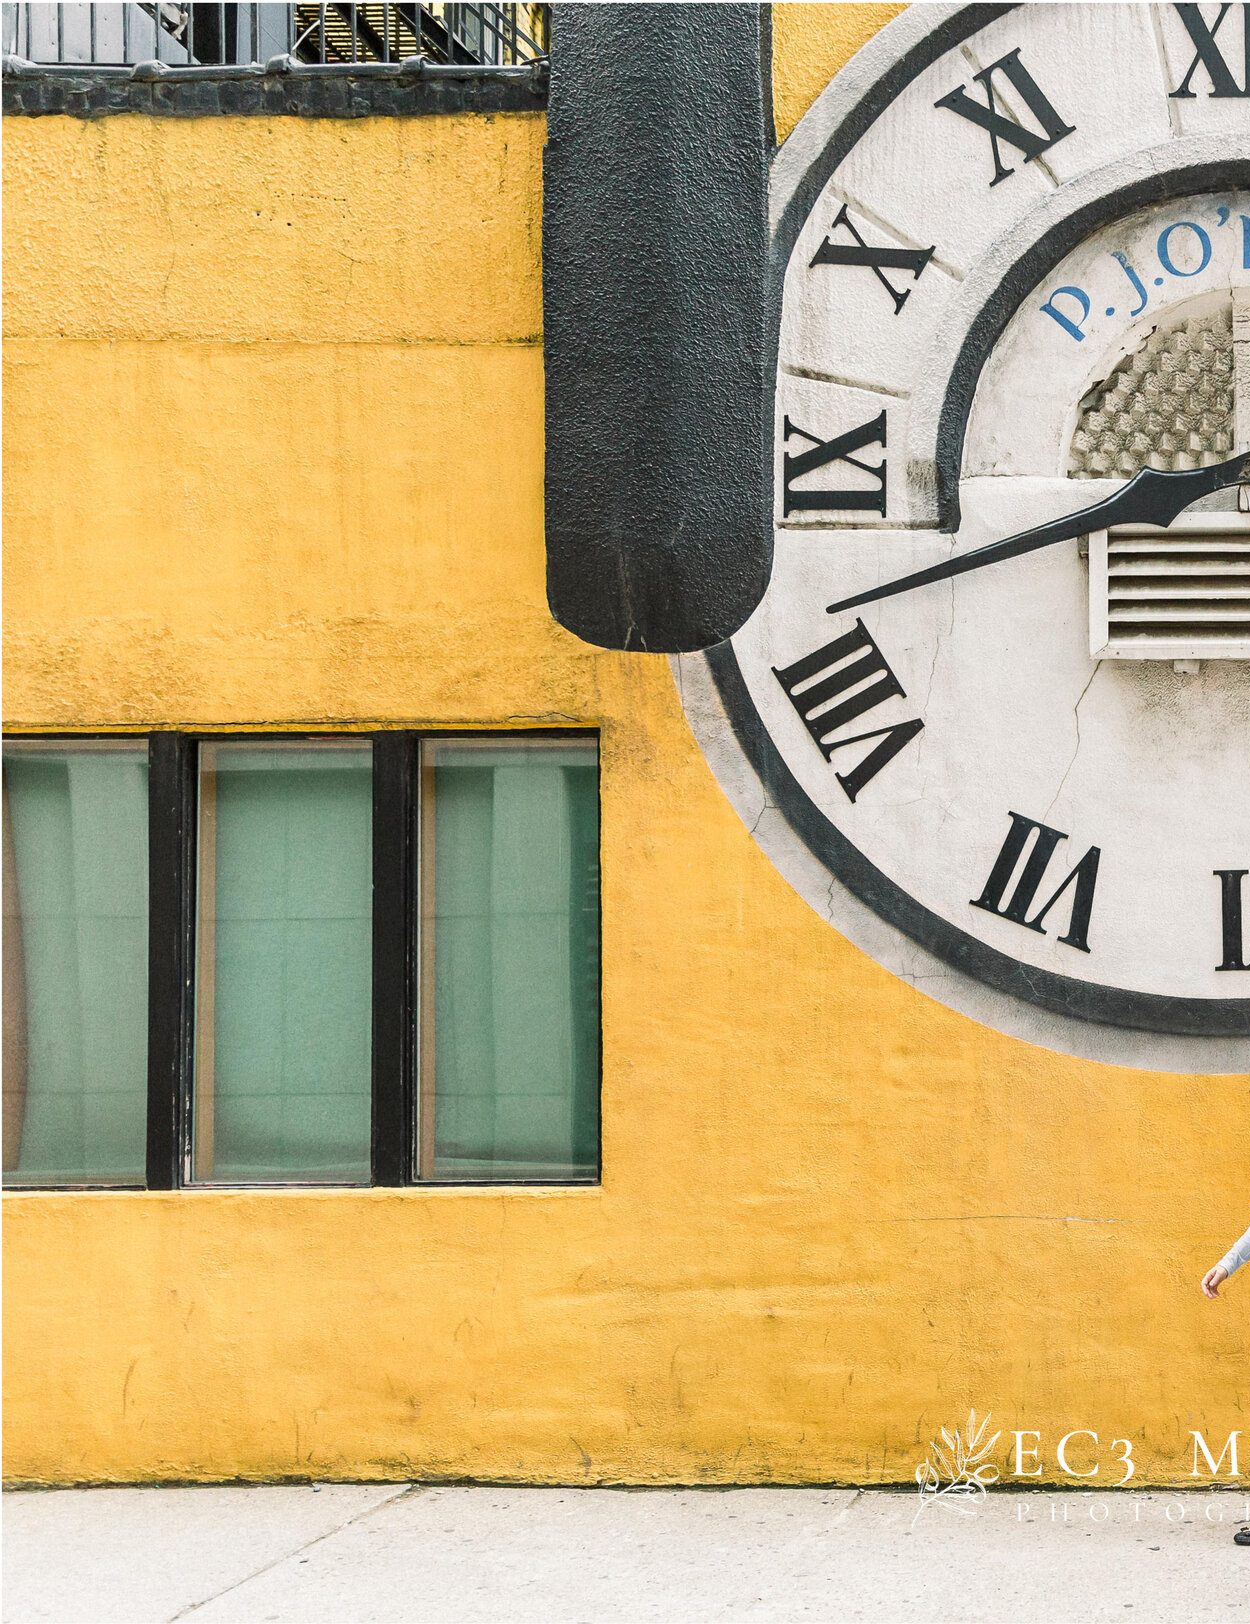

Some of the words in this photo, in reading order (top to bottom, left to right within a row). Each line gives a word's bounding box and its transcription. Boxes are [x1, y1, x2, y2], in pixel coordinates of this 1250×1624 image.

[935, 47, 1076, 187] XI
[808, 203, 935, 315] X
[784, 410, 886, 518] IX
[771, 617, 924, 803] VIII
[969, 811, 1100, 953] VII
